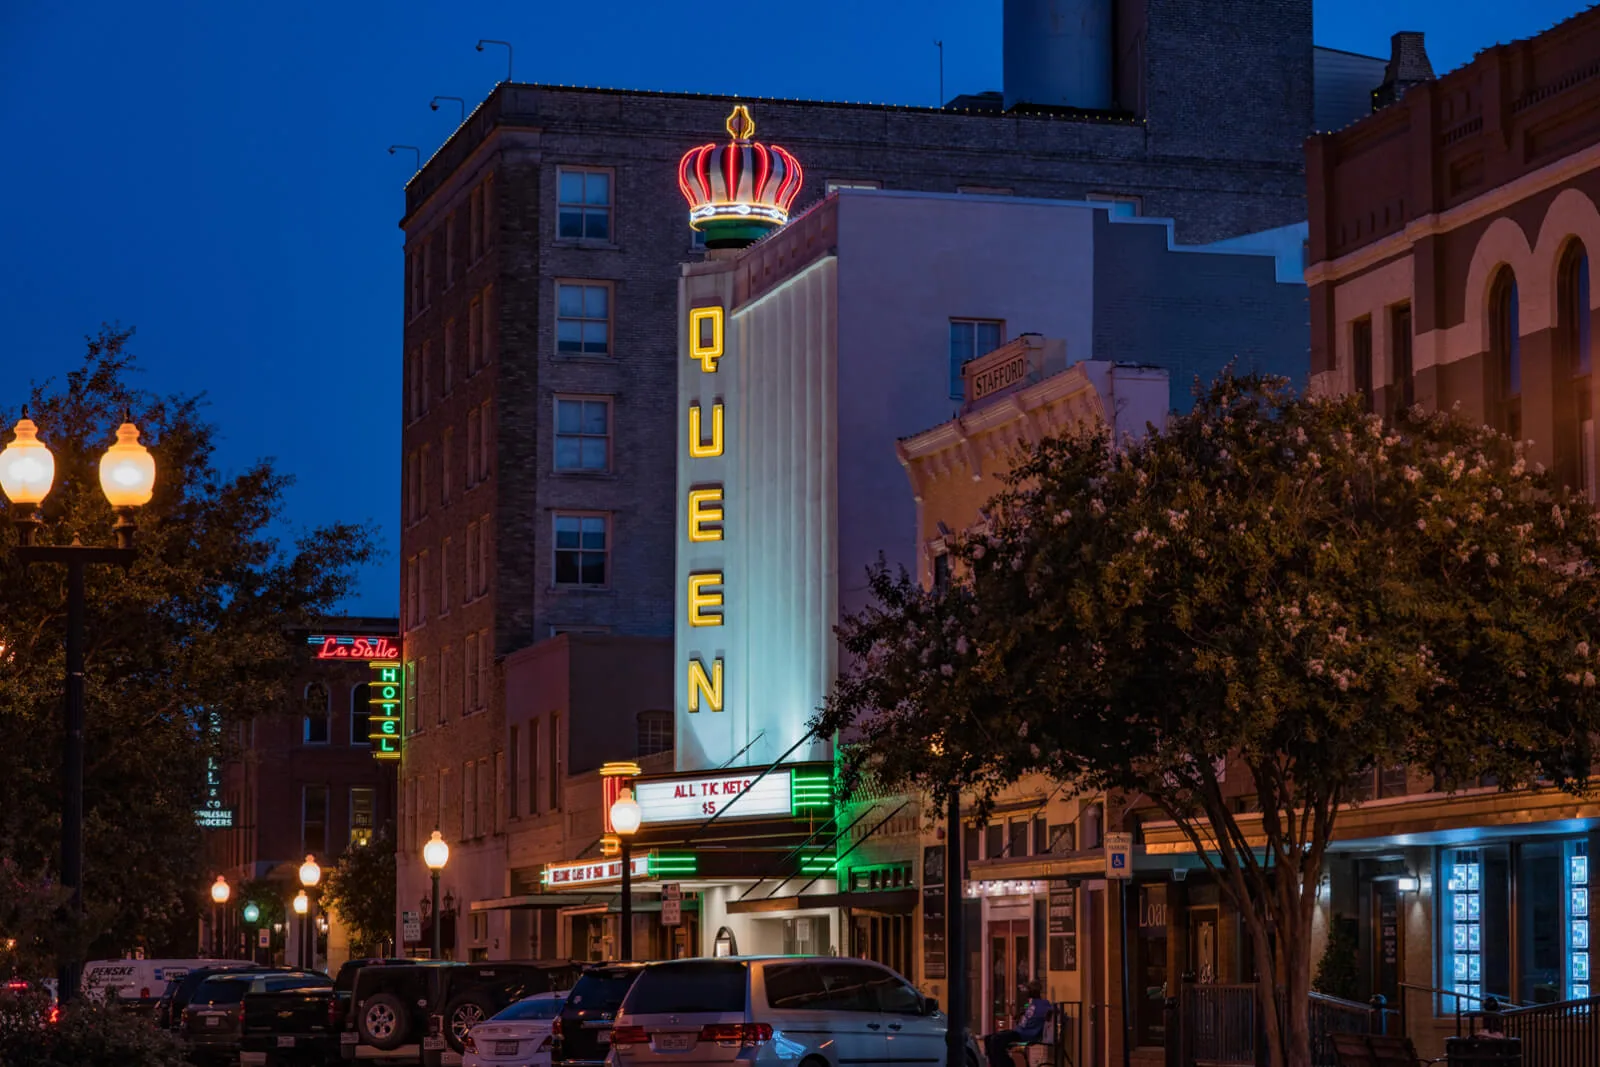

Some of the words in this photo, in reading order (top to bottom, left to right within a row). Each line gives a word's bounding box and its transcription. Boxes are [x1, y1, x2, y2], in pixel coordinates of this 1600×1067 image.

[976, 358, 1024, 396] STAFFORD
[688, 305, 725, 713] QUEEN
[318, 638, 349, 659] La
[351, 638, 399, 659] Salle
[381, 668, 396, 752] HOTEL
[674, 784, 696, 798] ALL
[702, 801, 716, 815] $5
[91, 966, 136, 976] PENSKE
